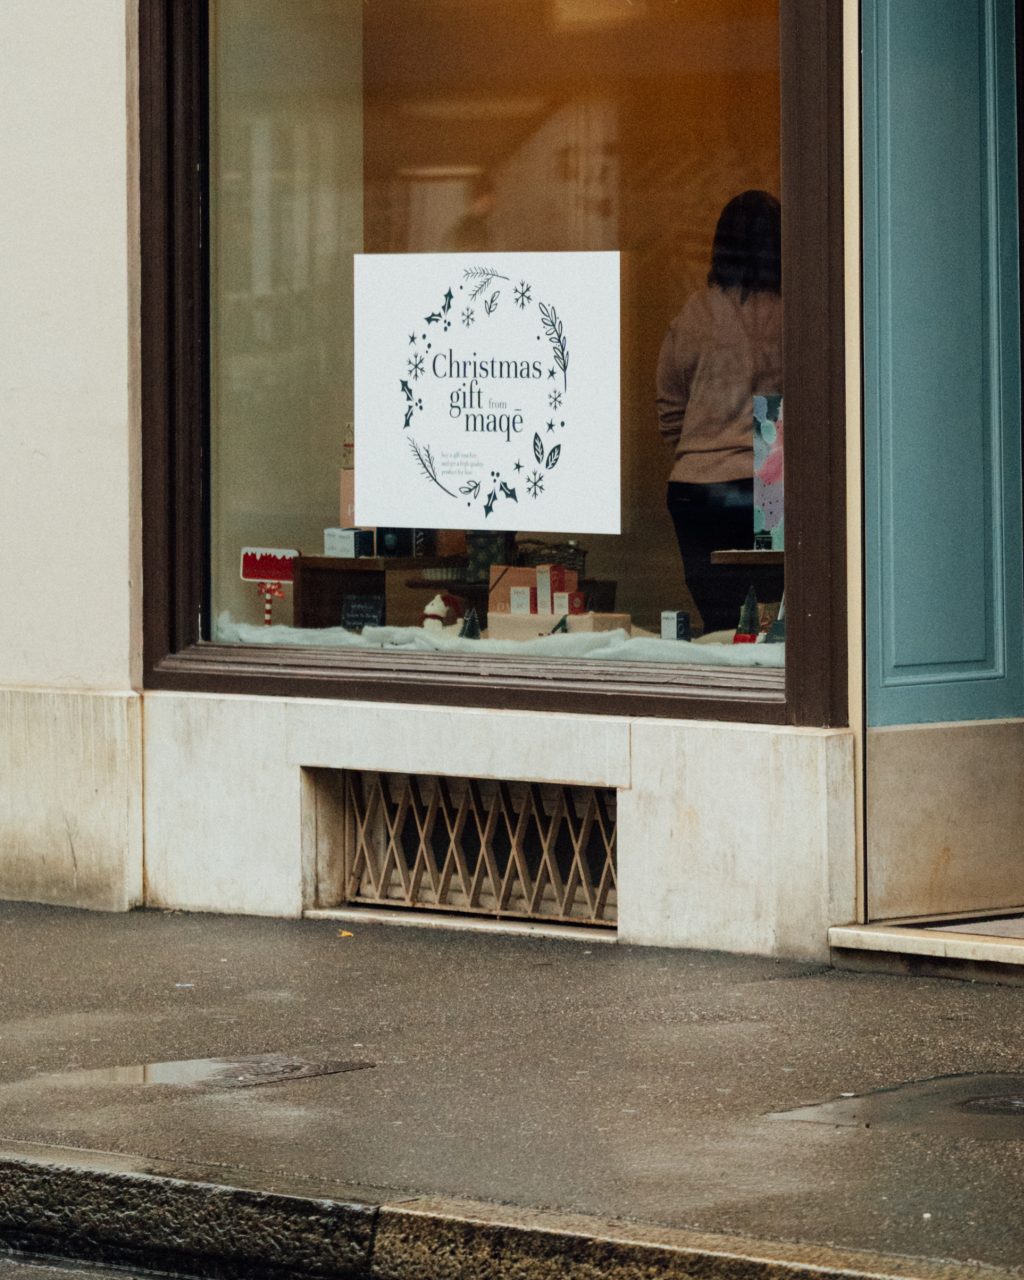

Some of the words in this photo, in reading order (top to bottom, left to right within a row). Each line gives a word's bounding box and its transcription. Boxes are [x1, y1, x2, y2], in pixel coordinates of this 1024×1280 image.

[432, 348, 542, 380] Christmas
[449, 379, 484, 418] gift
[488, 398, 507, 409] from
[464, 408, 524, 442] maqē
